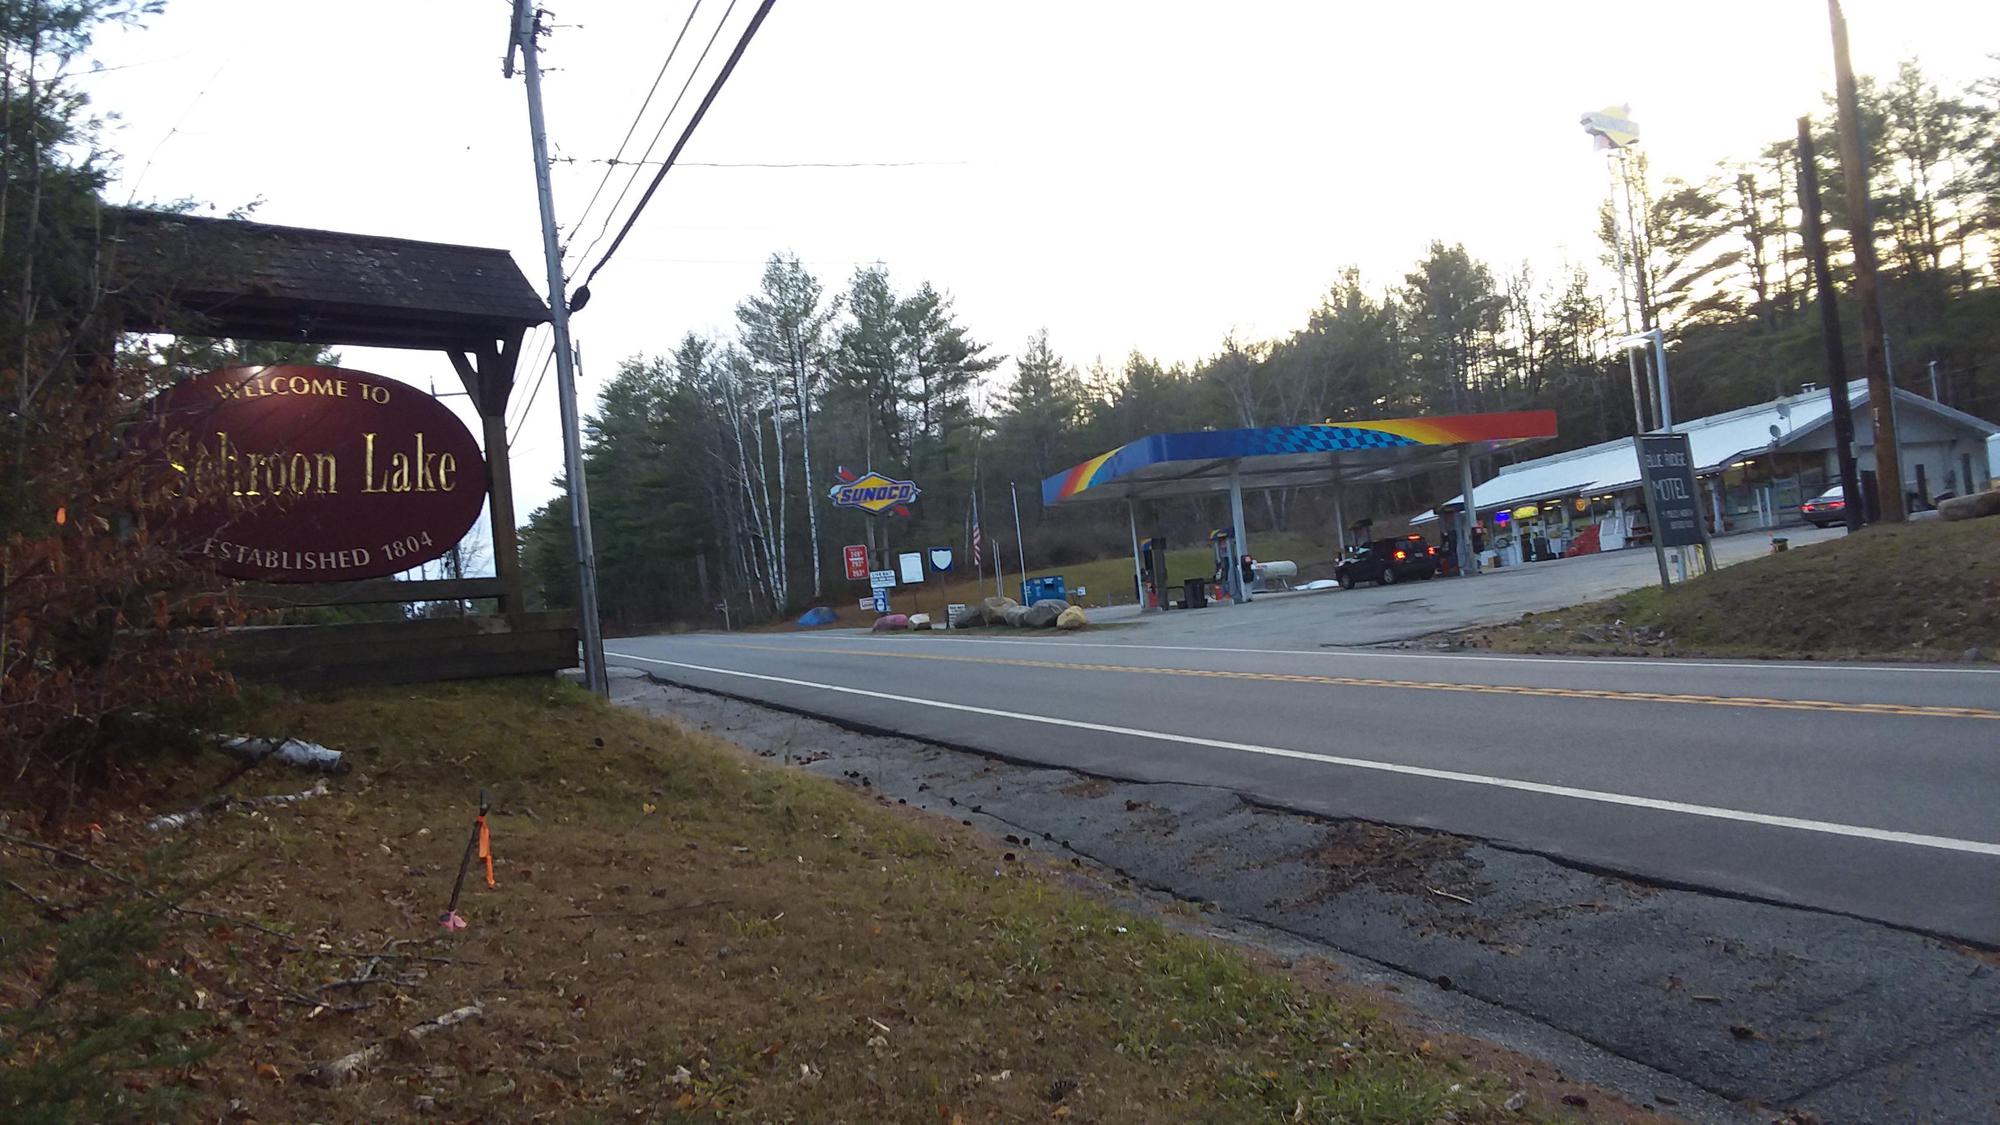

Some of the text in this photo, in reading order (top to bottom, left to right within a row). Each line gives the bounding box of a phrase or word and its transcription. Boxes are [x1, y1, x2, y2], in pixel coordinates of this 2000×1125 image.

[214, 376, 391, 405] WELCOME TO
[361, 432, 456, 493] Lake
[841, 484, 911, 502] SUNOCO
[1652, 477, 1690, 501] MOTEL
[202, 530, 433, 570] ESTABLISHED 1804
